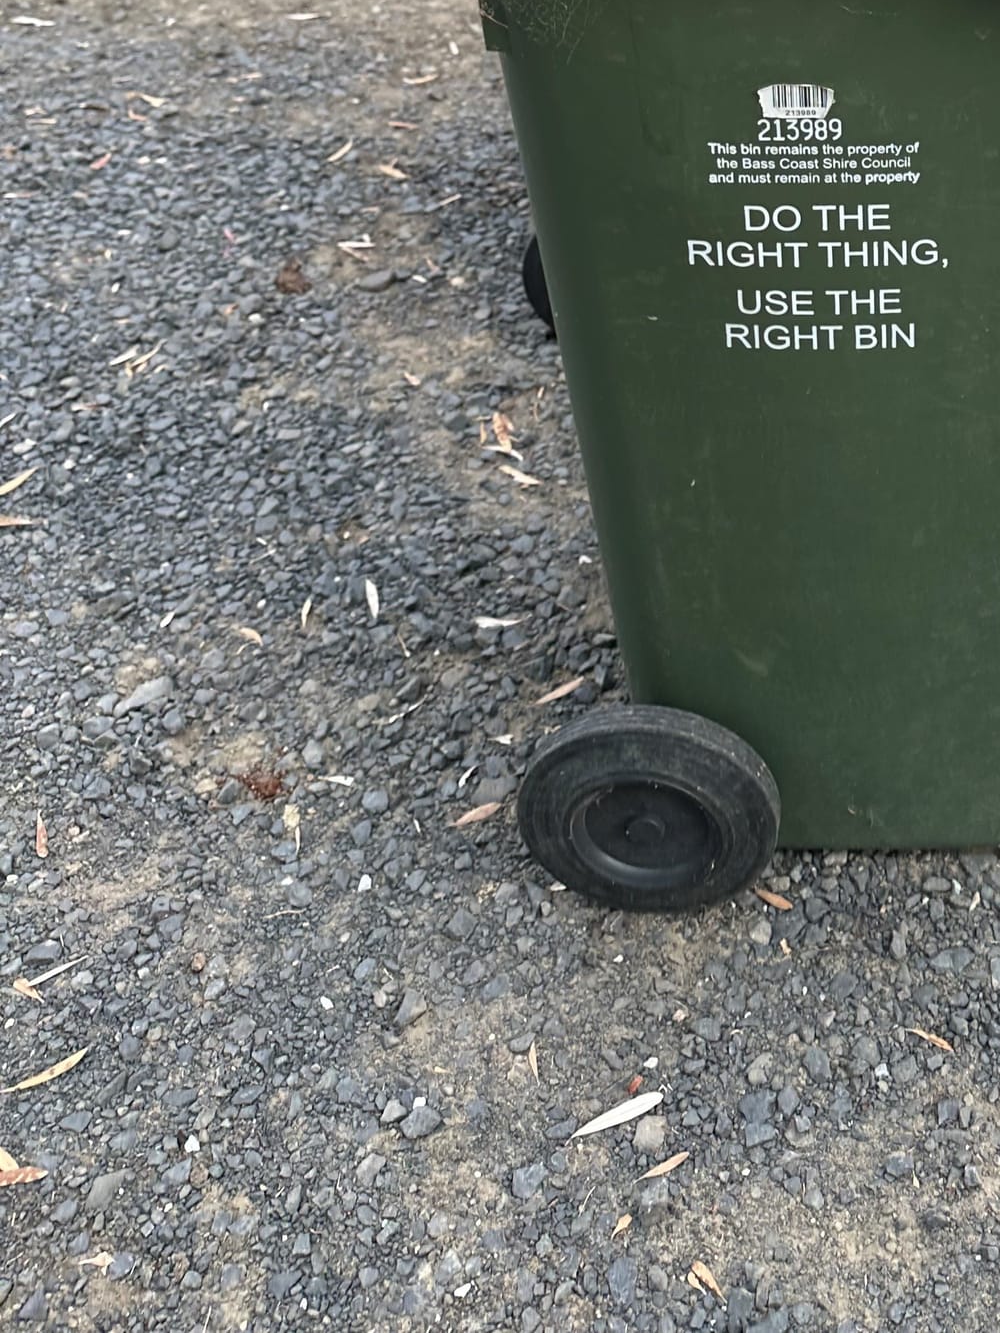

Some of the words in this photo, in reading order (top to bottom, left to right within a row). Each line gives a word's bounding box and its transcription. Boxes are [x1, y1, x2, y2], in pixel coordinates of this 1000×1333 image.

[757, 118, 842, 141] 213989
[707, 142, 737, 155] This
[740, 143, 761, 155] bin
[765, 143, 818, 155] remains
[822, 143, 843, 155] the
[847, 143, 902, 157] property
[905, 141, 920, 154] of
[716, 157, 738, 169] the
[742, 157, 775, 169] Bass
[779, 157, 819, 169] Coast
[822, 157, 857, 169] Shire
[861, 156, 911, 168] Council
[709, 171, 734, 183] and
[738, 172, 771, 184] must
[775, 172, 820, 183] remain
[824, 172, 837, 183] at
[840, 171, 861, 183] the
[865, 170, 920, 185] property
[743, 204, 801, 231] DO
[812, 204, 891, 231] THE
[687, 239, 808, 267] RIGHT
[818, 239, 949, 268] THING,
[737, 289, 814, 315] USE
[825, 289, 902, 315] THE
[725, 323, 843, 350] RIGHT
[855, 323, 915, 349] BIN
